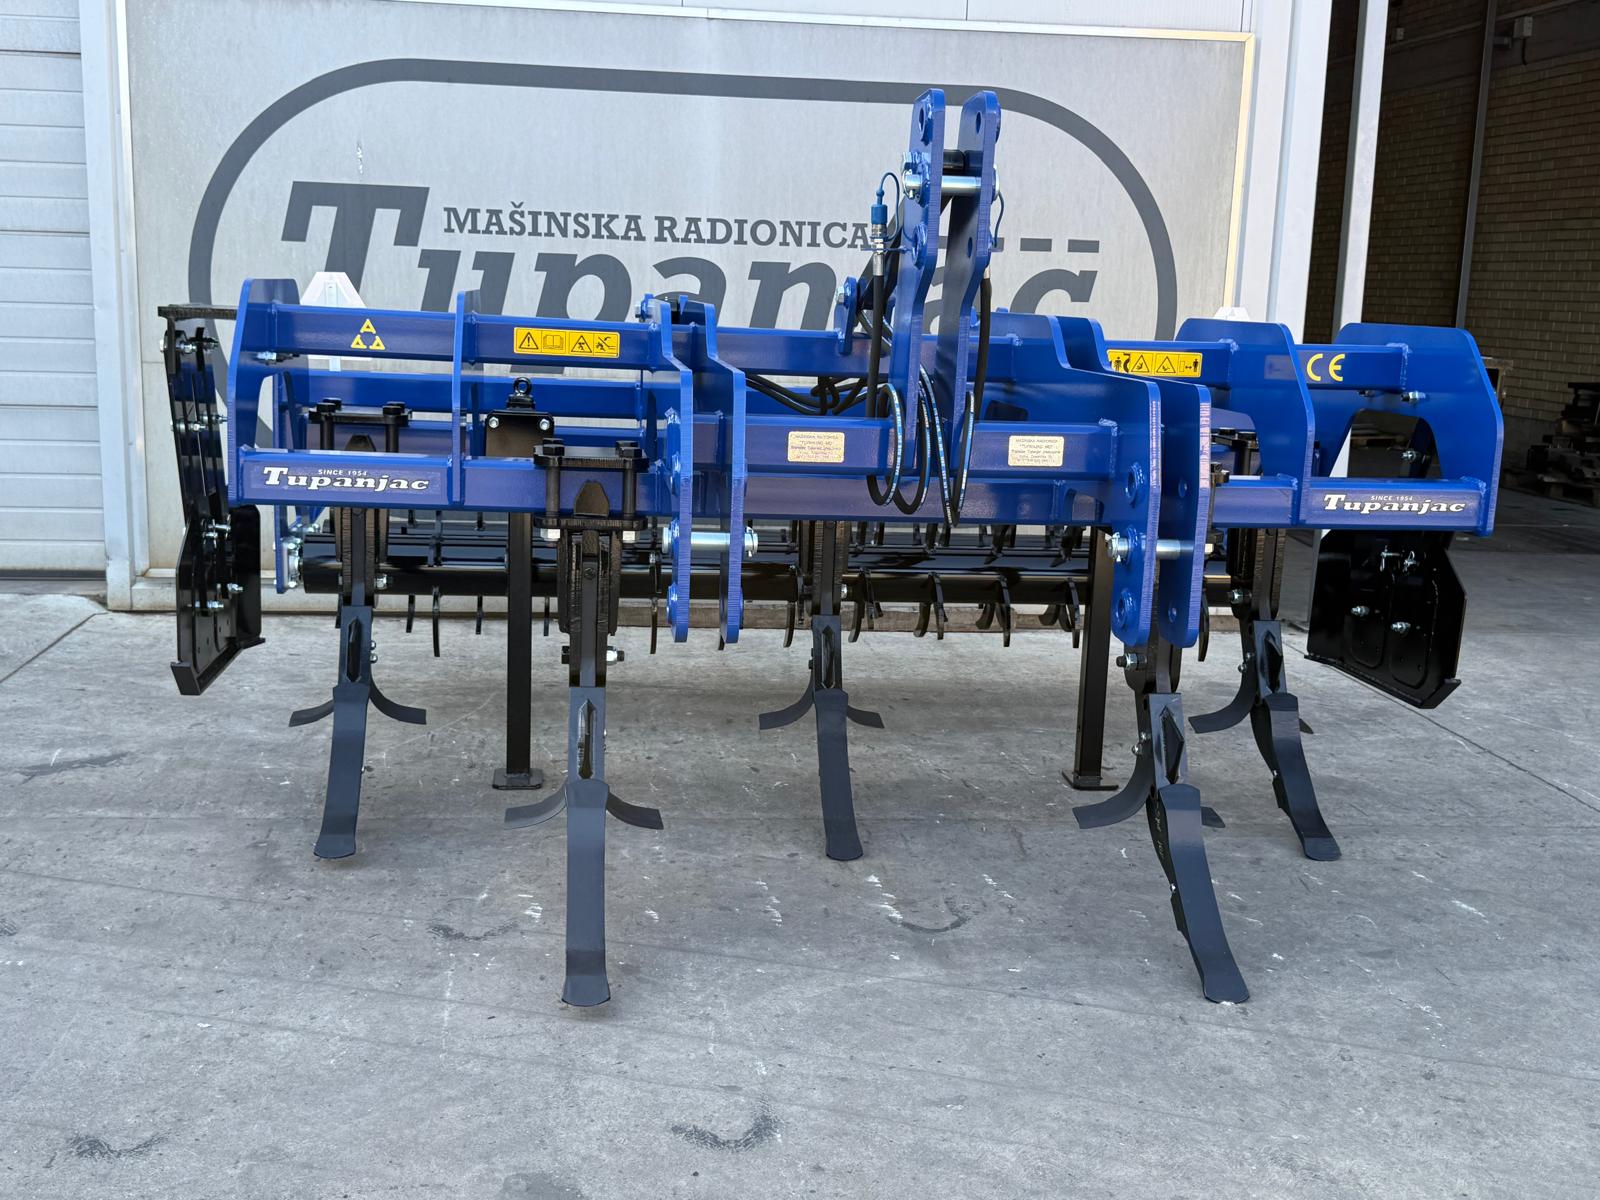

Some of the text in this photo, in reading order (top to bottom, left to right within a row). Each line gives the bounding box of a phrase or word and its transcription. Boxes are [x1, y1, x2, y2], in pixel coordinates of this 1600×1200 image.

[443, 201, 873, 249] MAŠINSKA RADIONICA
[1306, 353, 1346, 382] CE
[263, 466, 429, 492] Tupanjac
[318, 468, 344, 476] SINCE
[1324, 494, 1466, 515] Tupanjac
